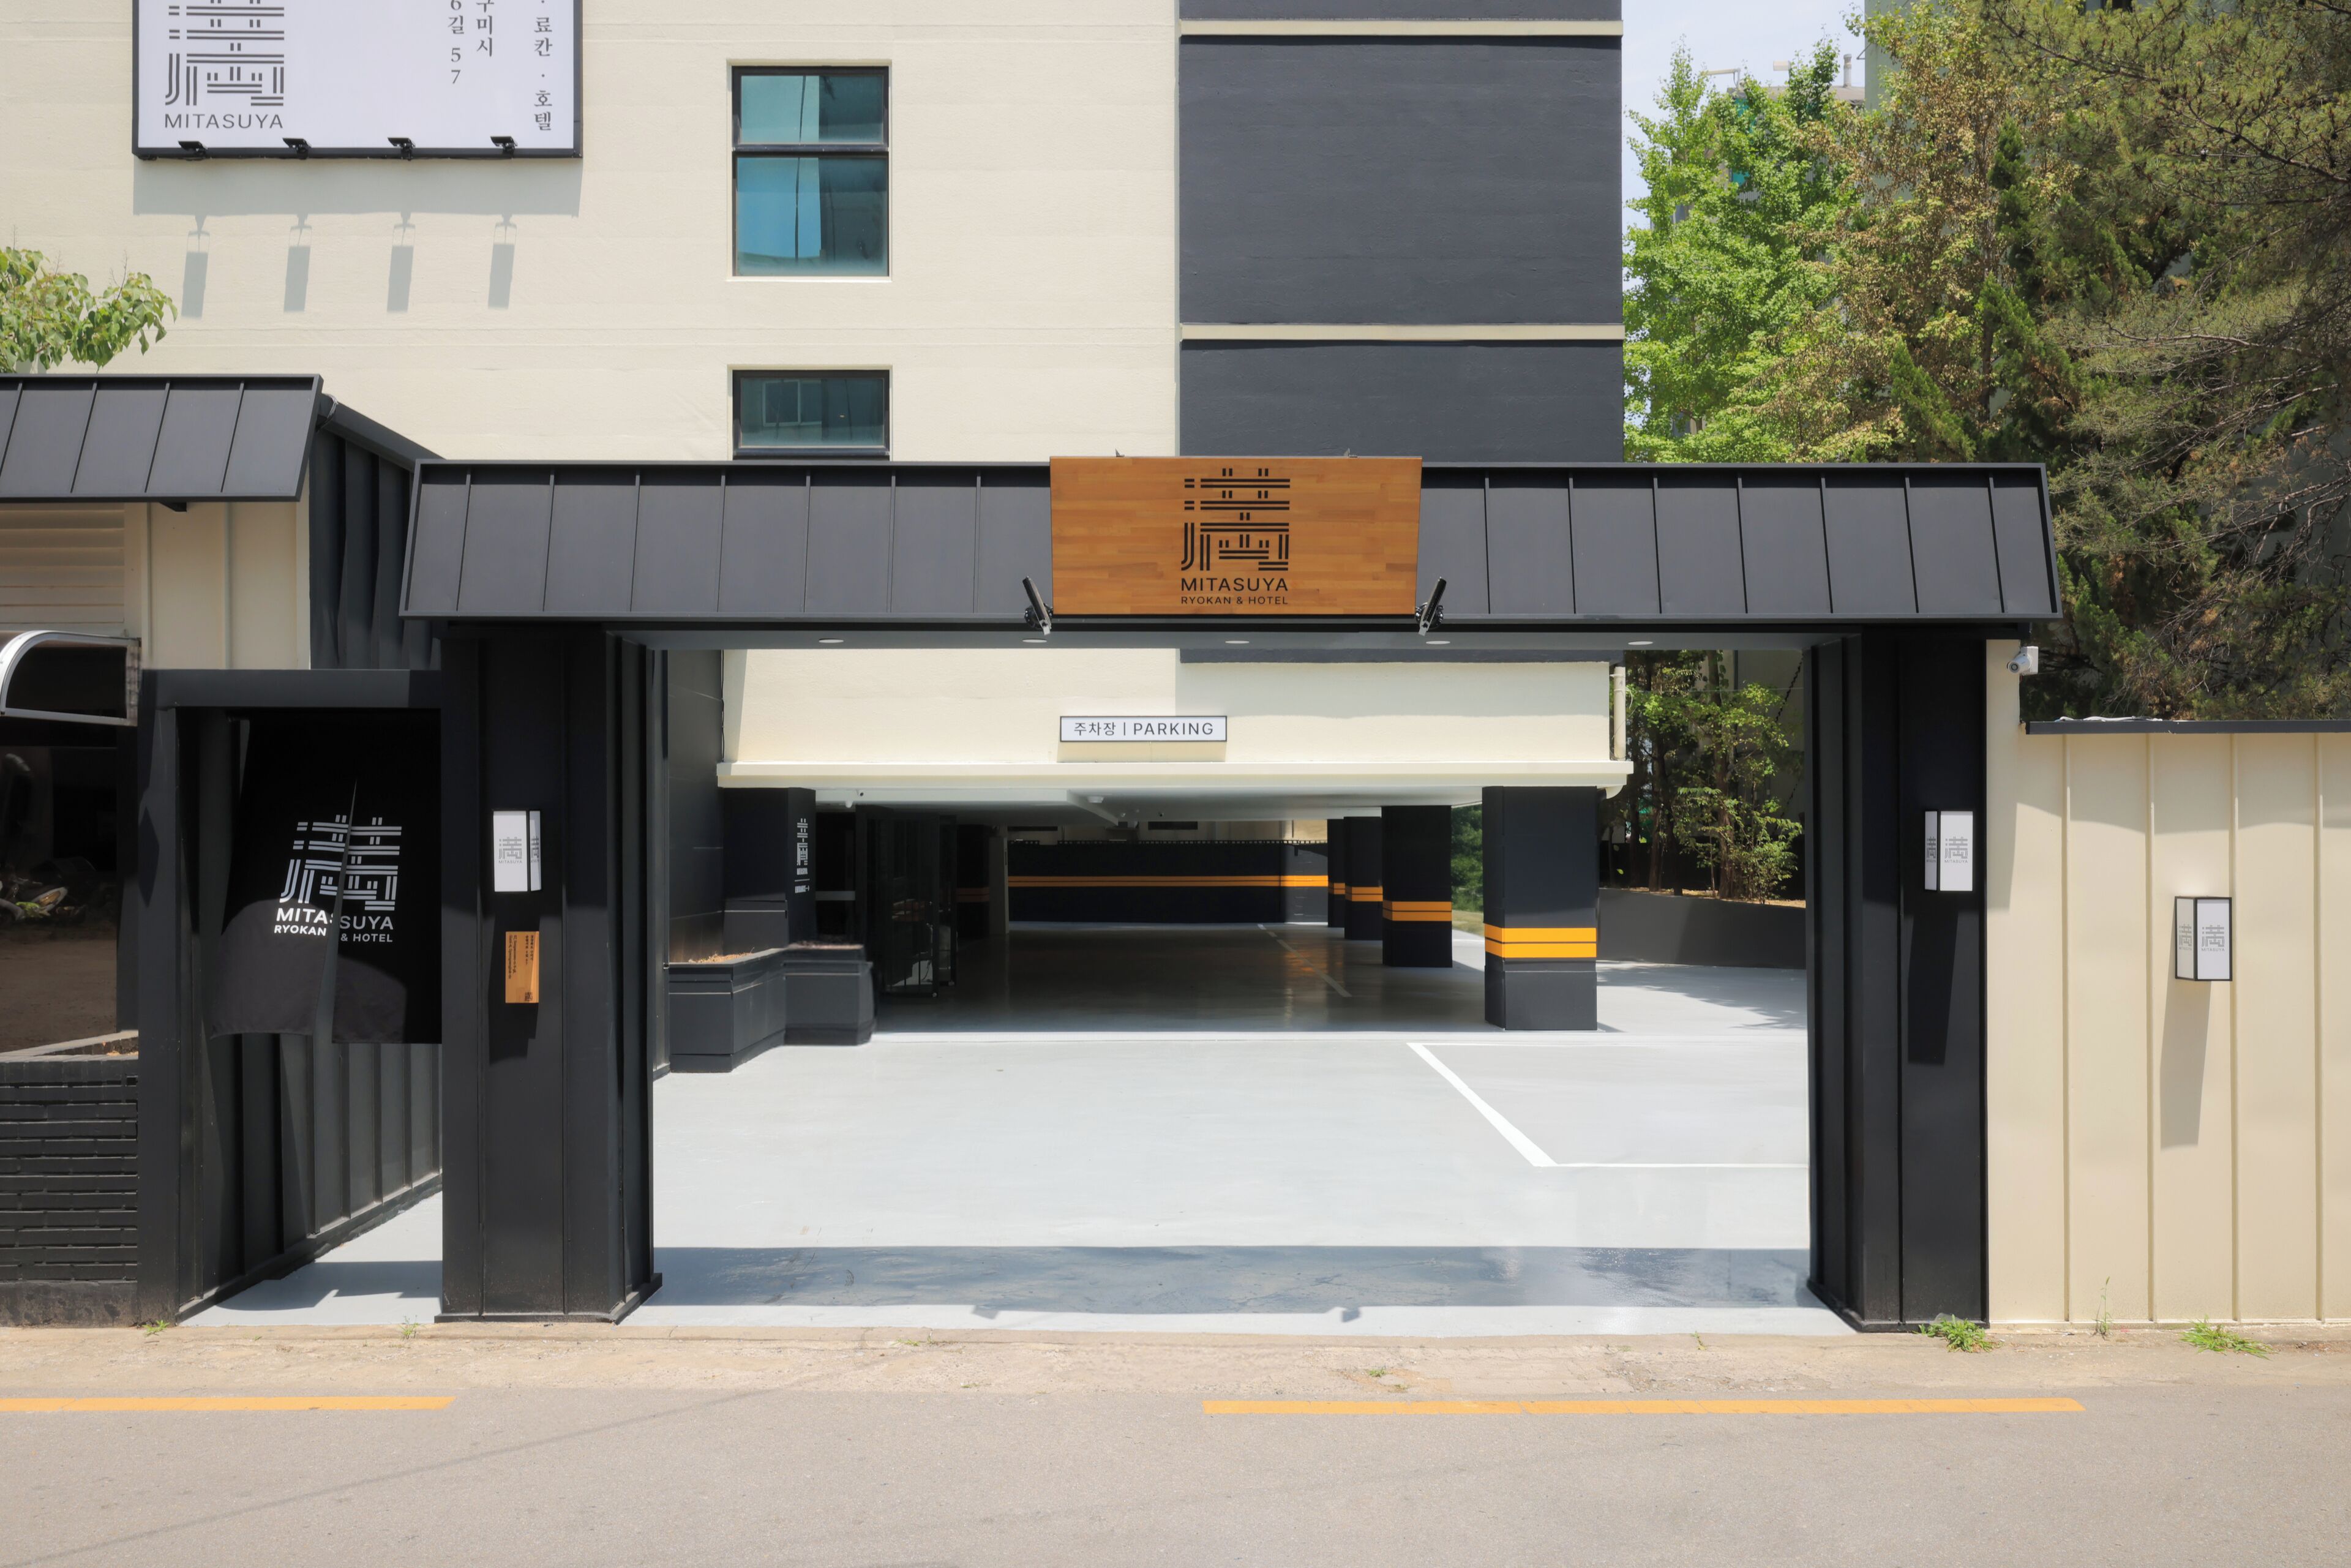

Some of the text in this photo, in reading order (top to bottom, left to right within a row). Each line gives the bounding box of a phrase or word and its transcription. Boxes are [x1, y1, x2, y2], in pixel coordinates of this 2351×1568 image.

[165, 113, 283, 129] MITASUYA
[1181, 577, 1288, 591] MITASUYA
[1236, 596, 1243, 605] &
[1248, 596, 1288, 605] HOTEL
[1074, 722, 1116, 736] 주차장
[1133, 722, 1213, 735] PARKING
[274, 925, 393, 942] RYOKAN & HOTEL
